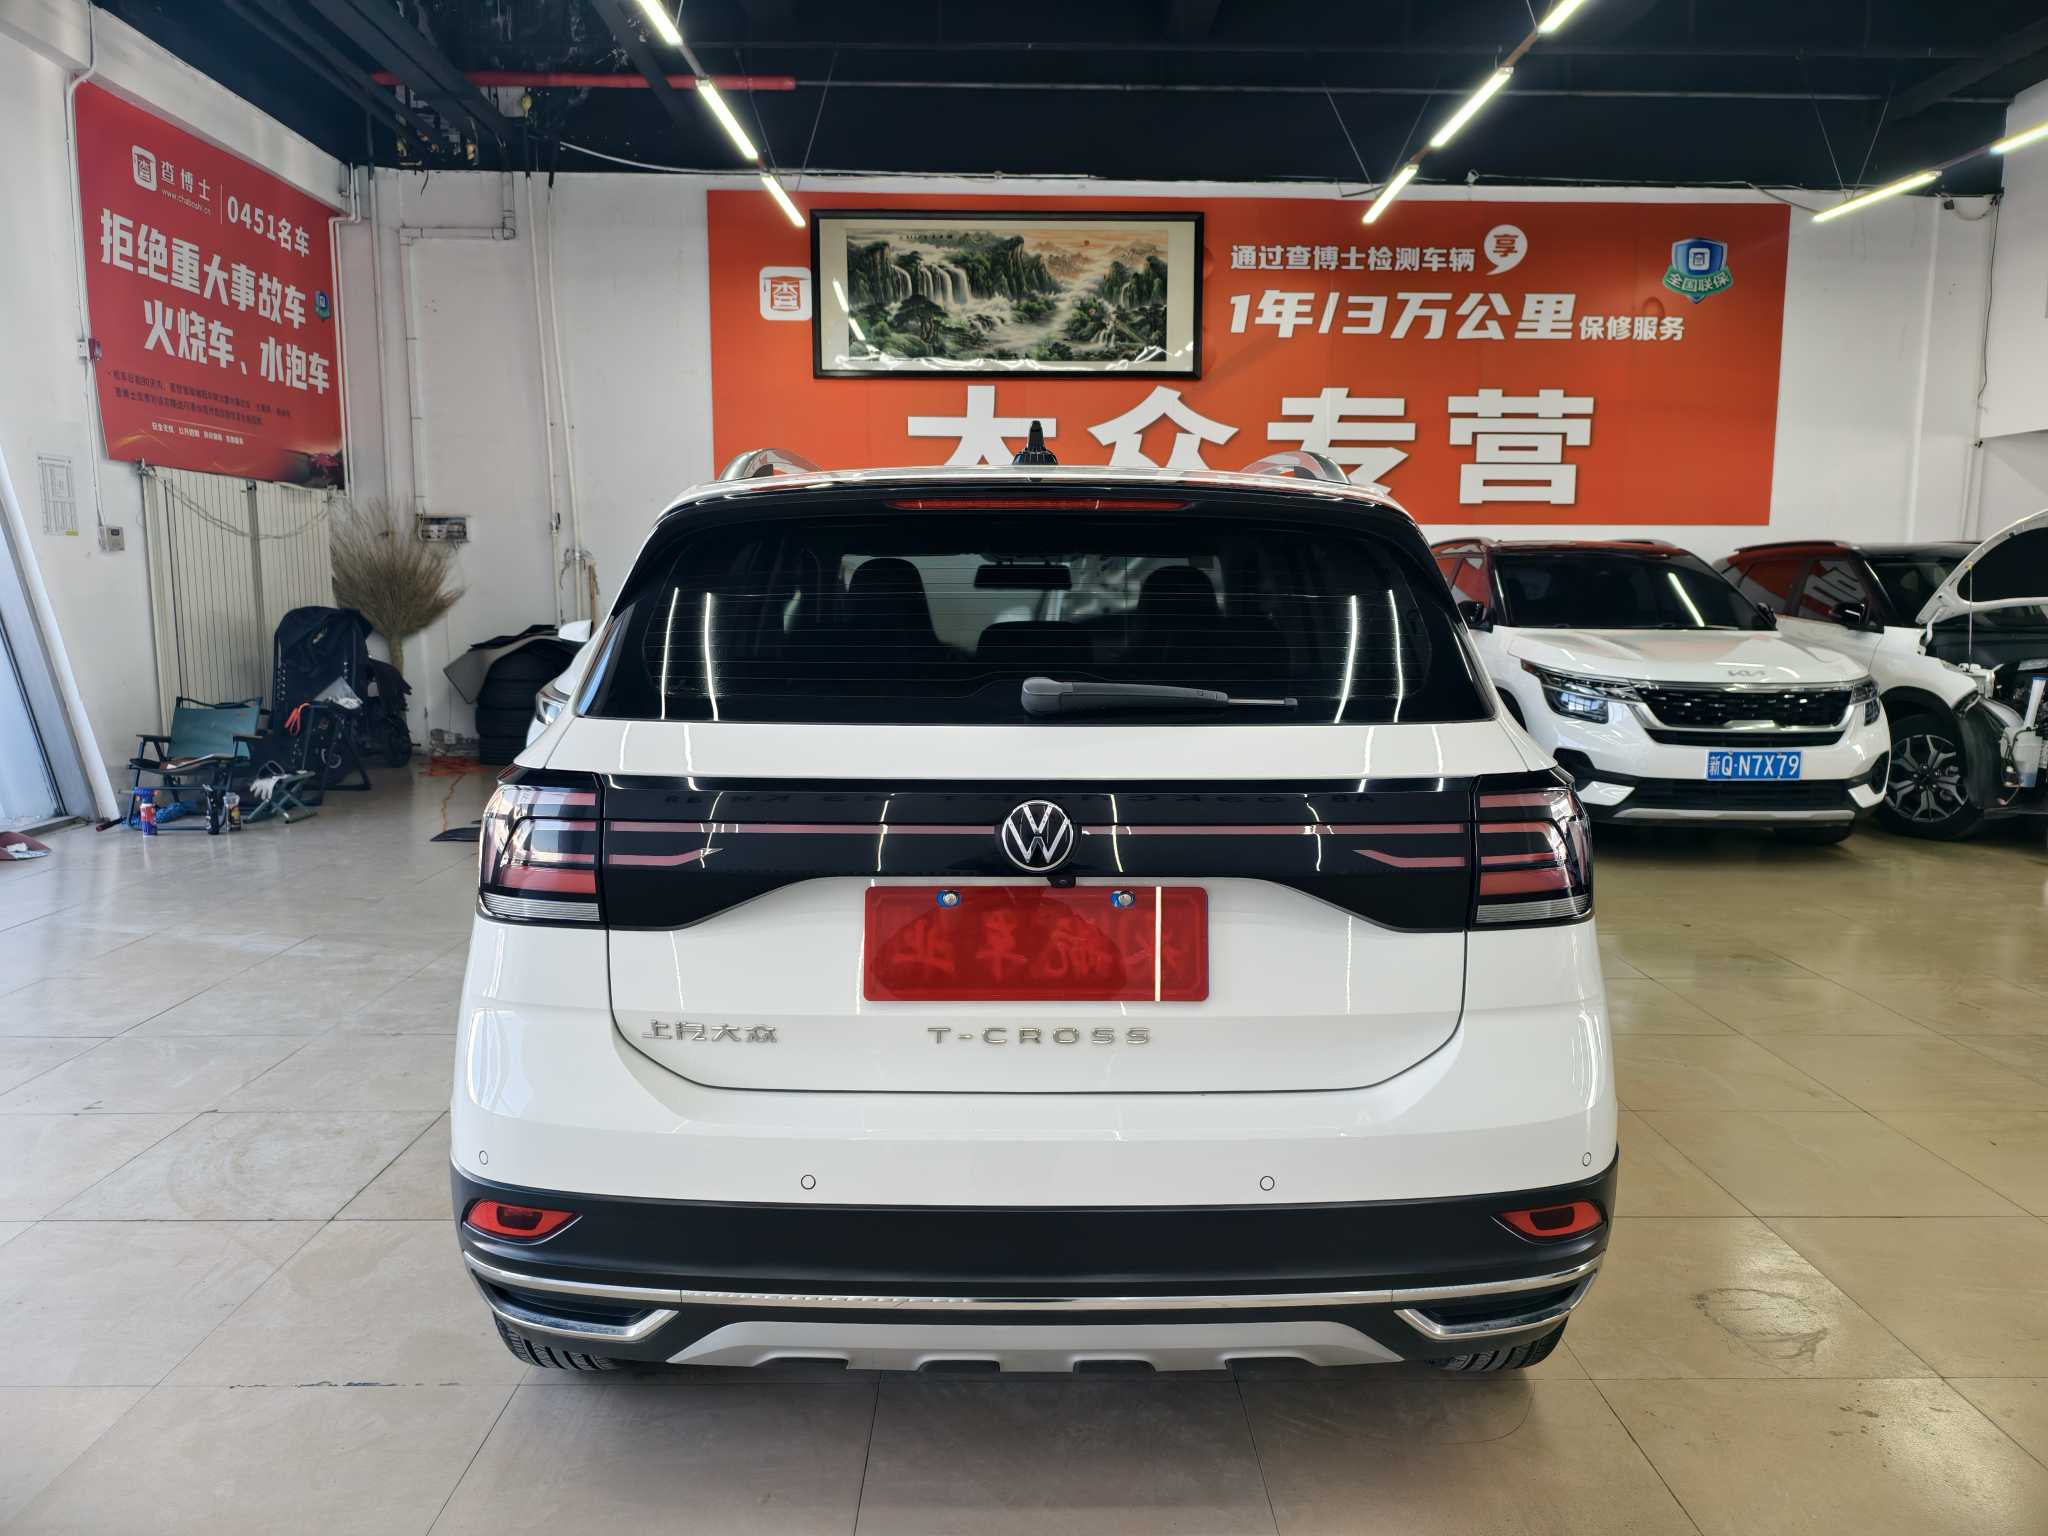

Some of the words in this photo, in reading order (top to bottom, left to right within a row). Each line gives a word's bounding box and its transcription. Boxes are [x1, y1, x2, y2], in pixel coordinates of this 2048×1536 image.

[161, 160, 211, 201] 查博士
[227, 195, 311, 257] 0451名车
[100, 208, 307, 329] 拒绝重大事故车
[1230, 244, 1476, 272] 通过查博士检测车辆
[143, 300, 330, 394] 火烧车、水泡车
[640, 1019, 777, 1043] 上汽大众
[927, 1026, 1151, 1045] T-CROSS
